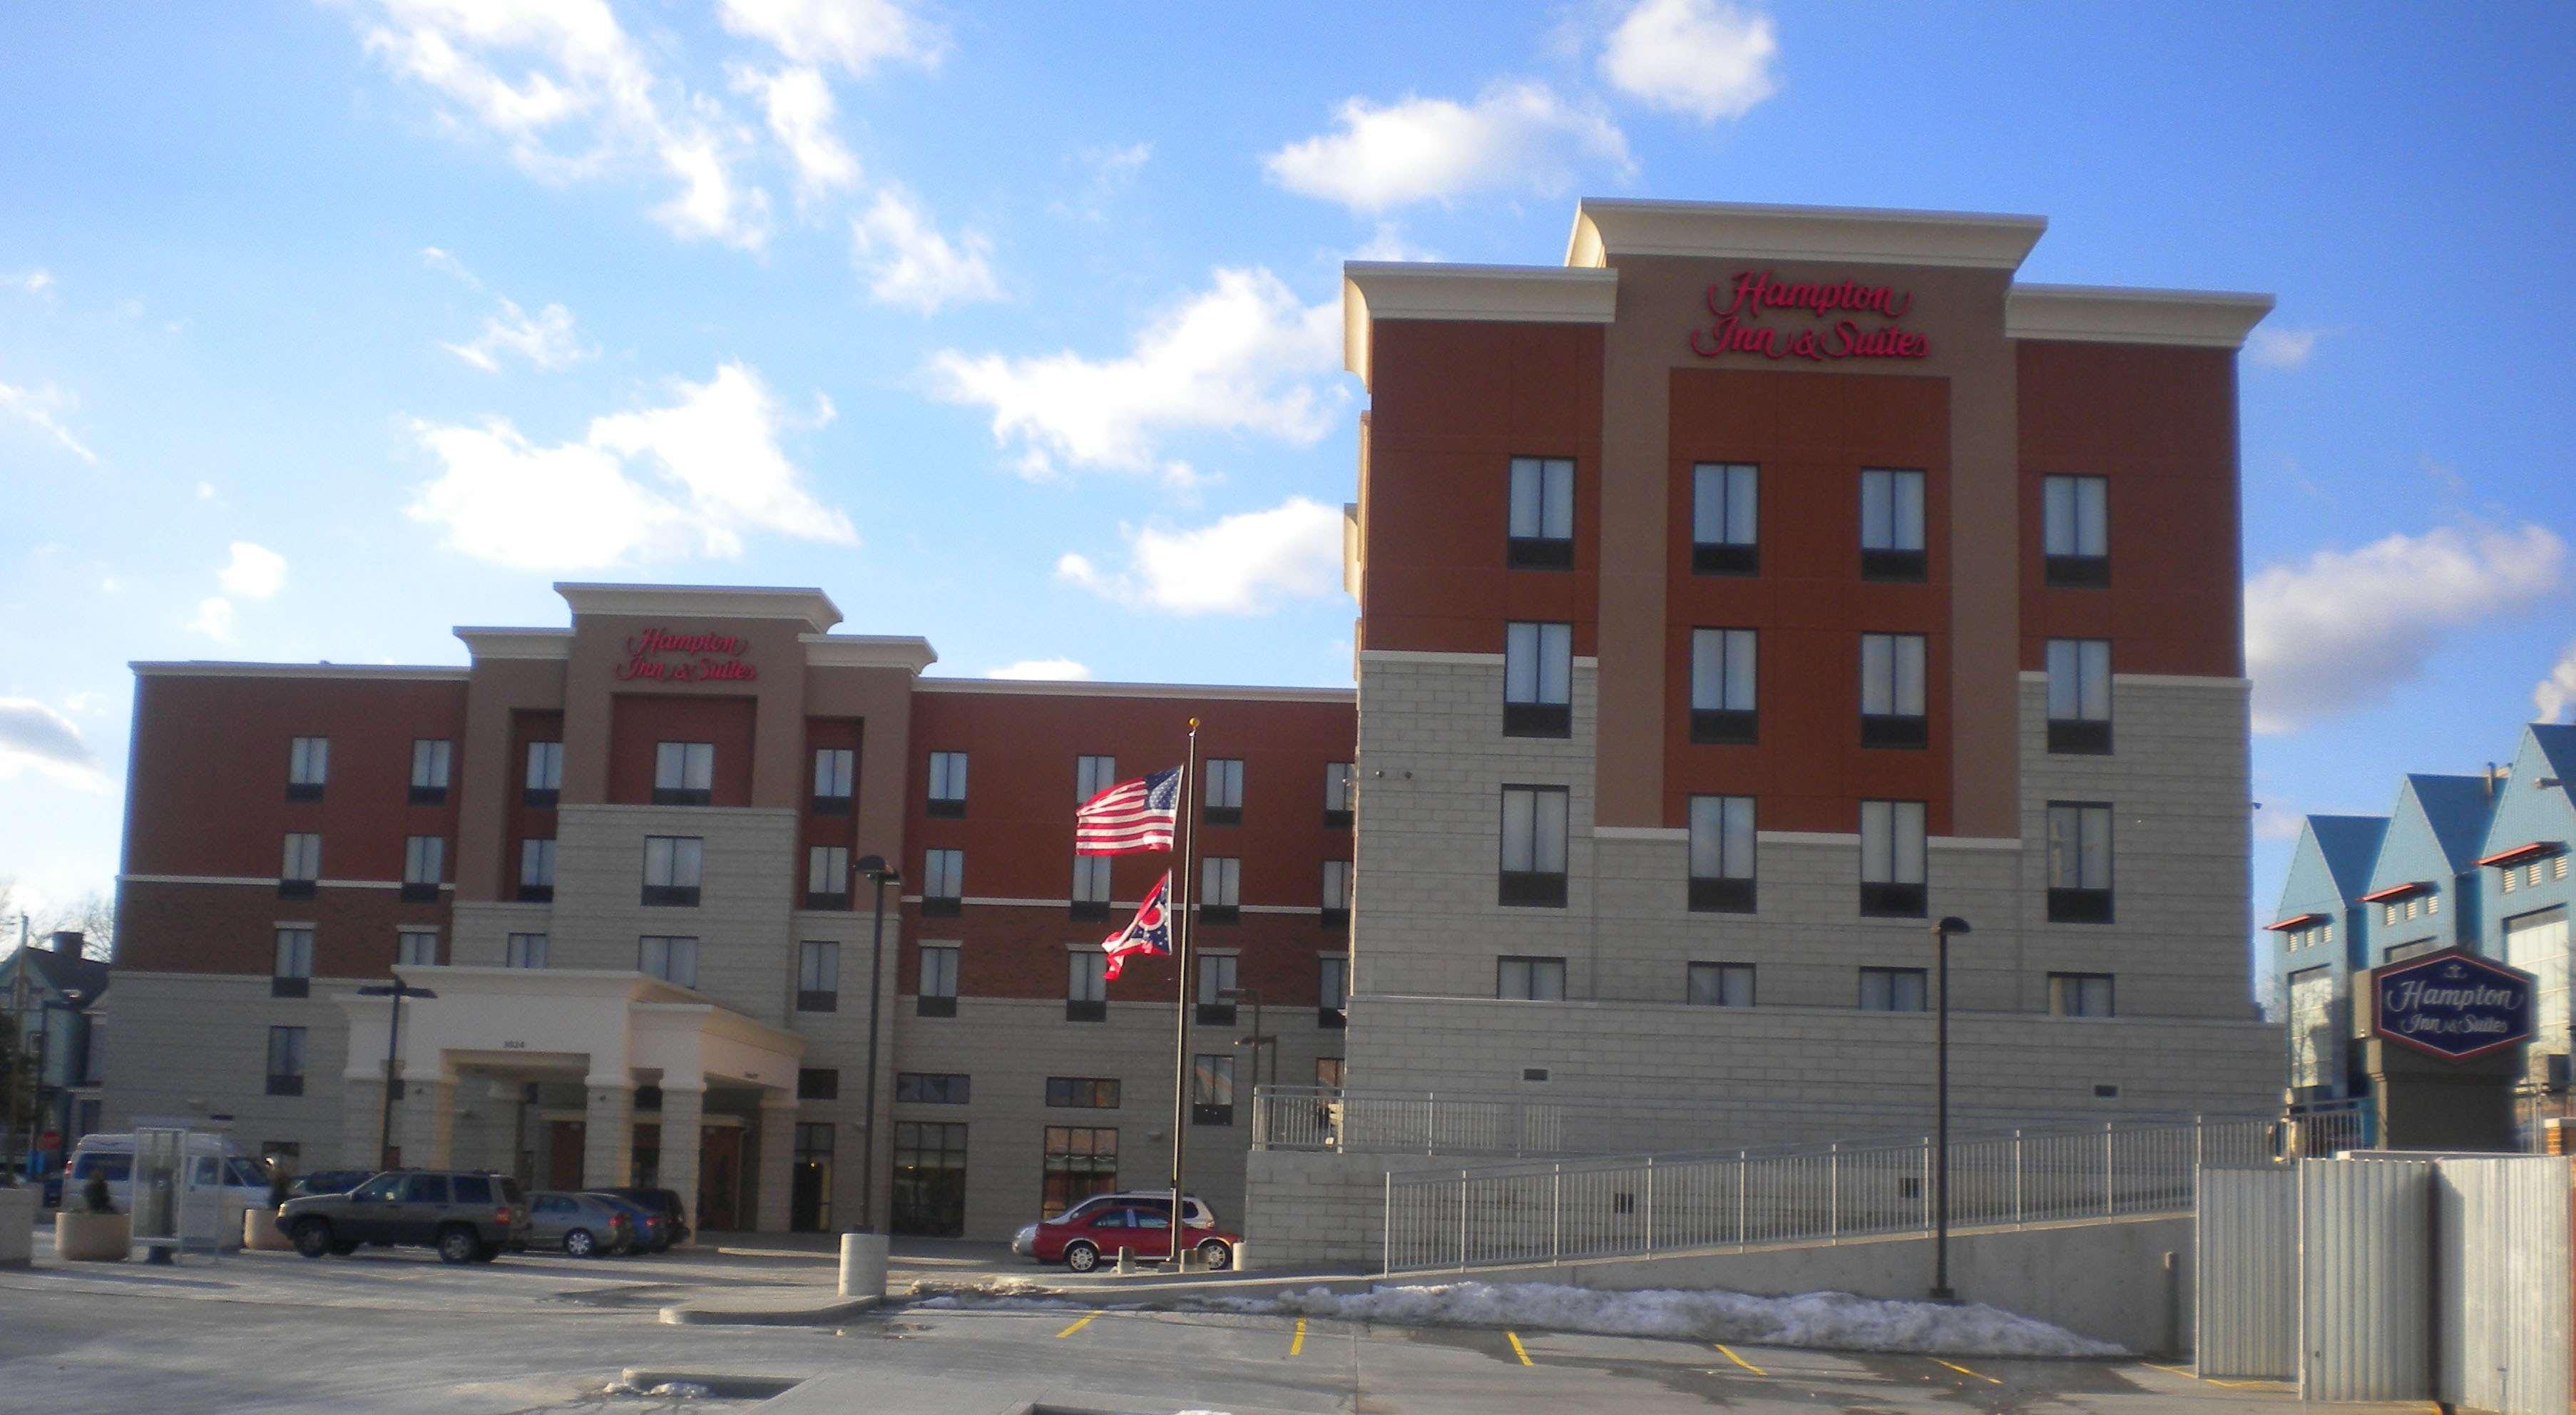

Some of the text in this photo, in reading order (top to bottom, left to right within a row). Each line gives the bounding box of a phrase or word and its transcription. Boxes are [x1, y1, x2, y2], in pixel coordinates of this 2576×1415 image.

[1707, 269, 1912, 317] Hampton
[1691, 317, 1928, 361] Inn & Suites
[626, 627, 752, 655] Hampton
[615, 653, 669, 682] Inn
[695, 658, 757, 682] Suites
[2387, 981, 2523, 1011] Hampton
[2400, 1013, 2446, 1034] Inn
[2459, 1014, 2508, 1033] Suites
